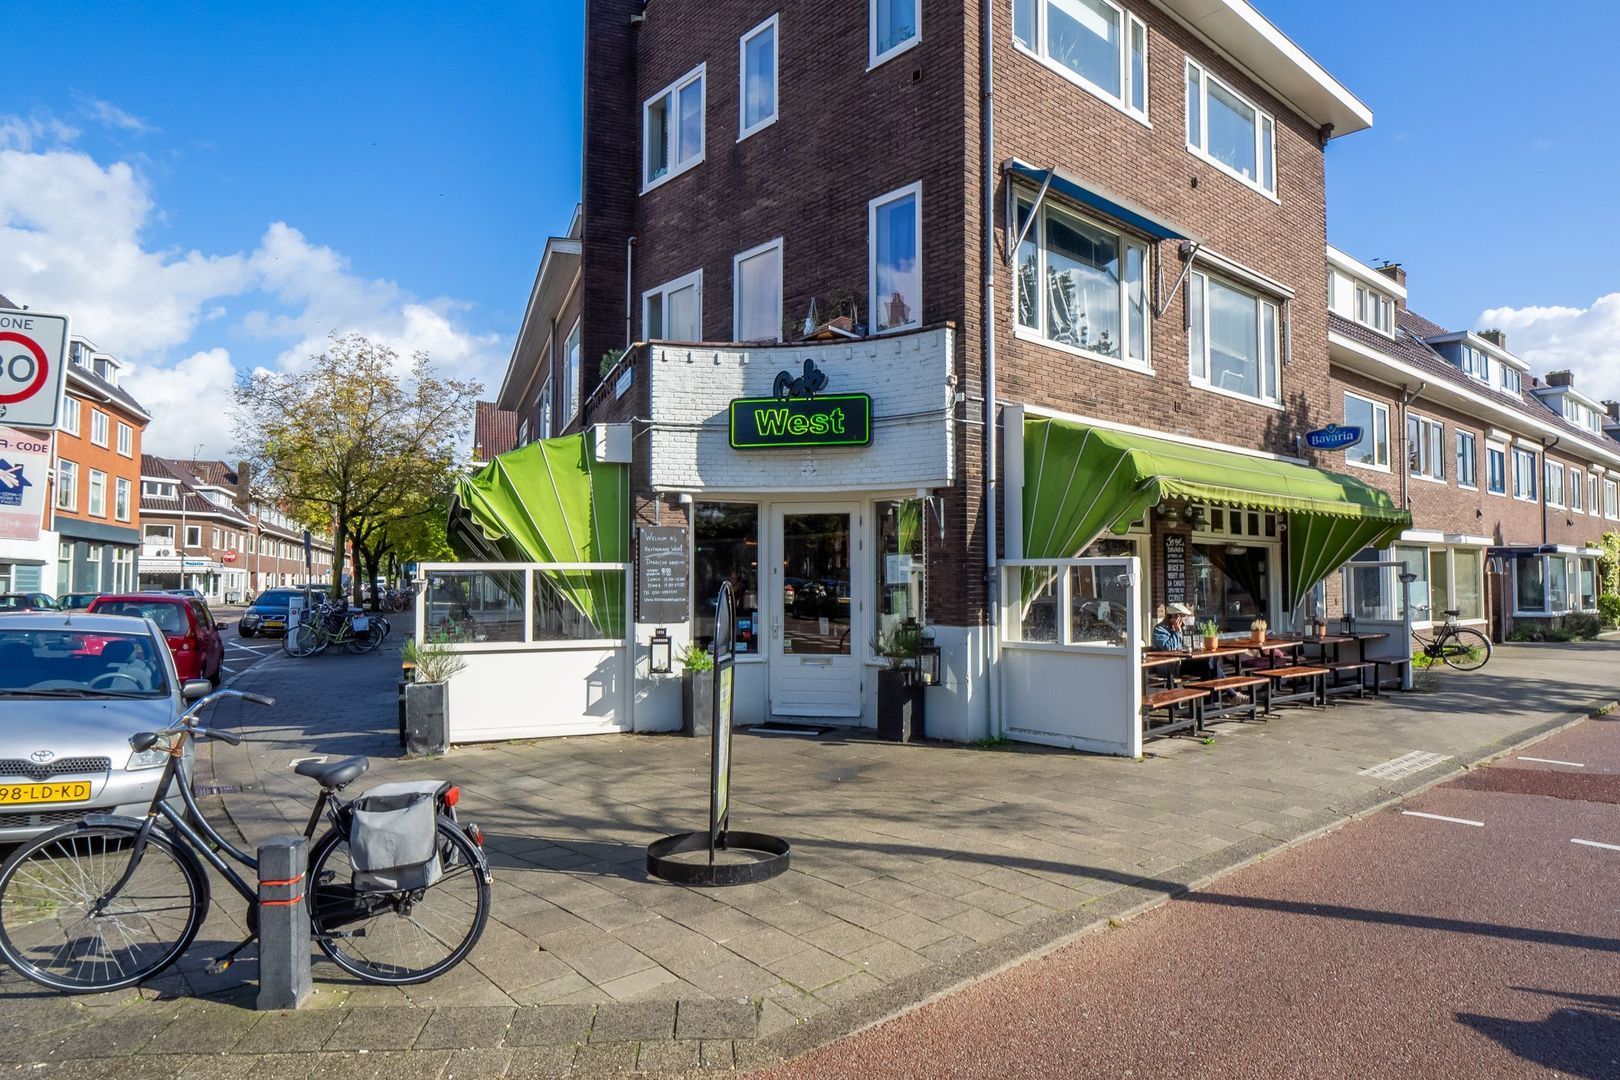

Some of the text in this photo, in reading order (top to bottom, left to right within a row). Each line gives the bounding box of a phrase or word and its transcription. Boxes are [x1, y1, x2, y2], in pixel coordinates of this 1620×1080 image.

[0, 355, 35, 382] 0
[755, 407, 845, 436] West
[1311, 432, 1354, 445] Bavaria
[0, 785, 85, 801] 98-LD-KD
